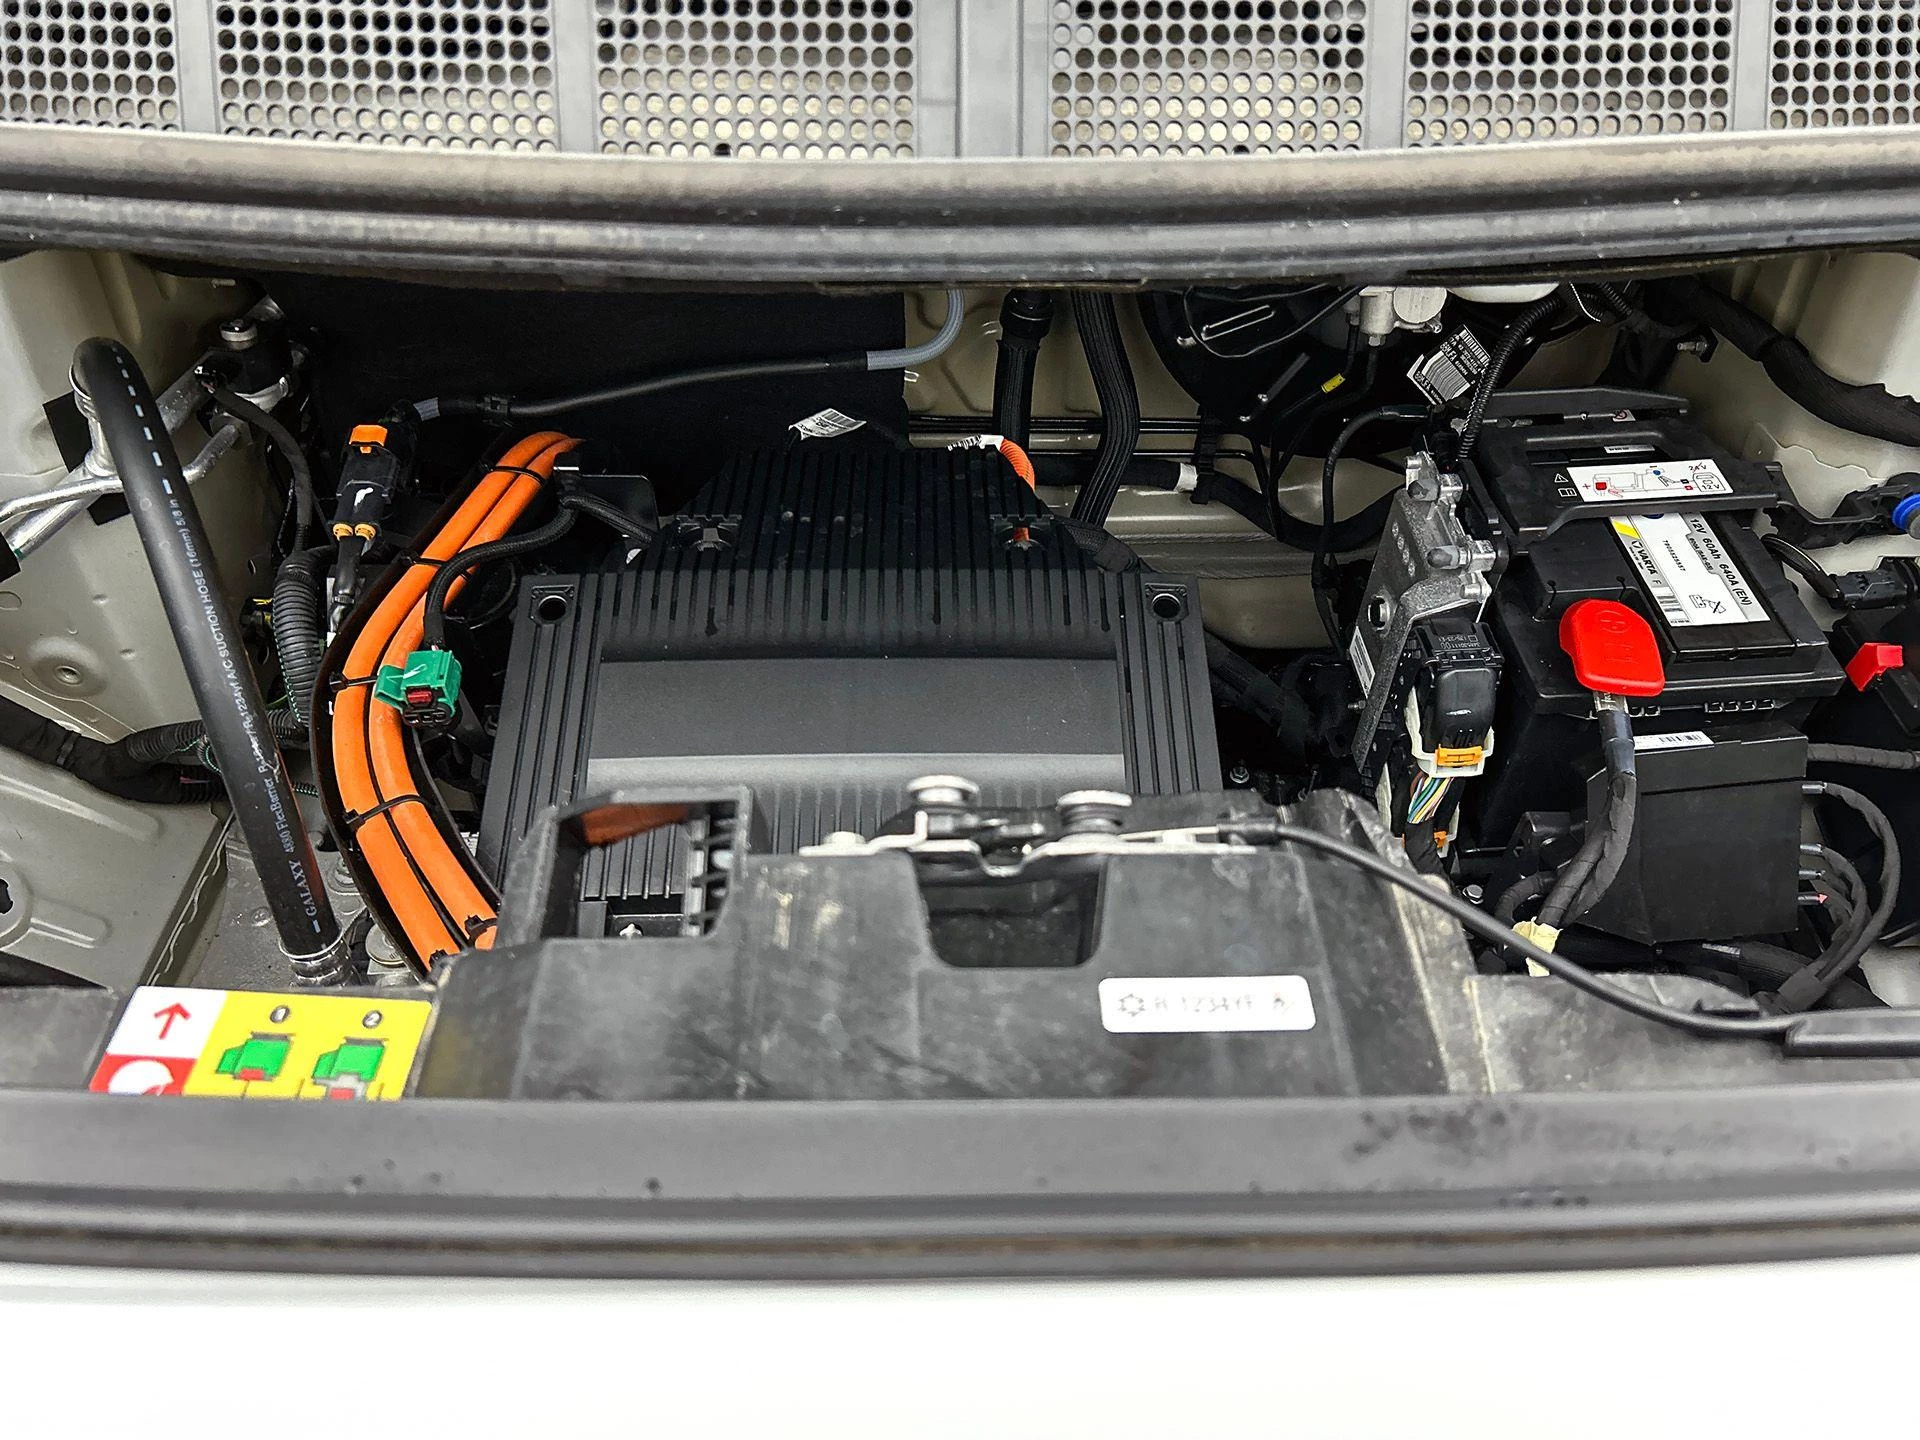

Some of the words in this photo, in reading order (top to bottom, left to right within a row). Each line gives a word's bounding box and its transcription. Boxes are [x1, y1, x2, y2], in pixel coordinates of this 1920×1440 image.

[178, 528, 202, 567] (16mm)
[1636, 549, 1658, 575] VARTA
[1690, 518, 1706, 534] 12V
[1702, 537, 1721, 560] 60Ah
[1719, 563, 1739, 586] 640A
[1732, 588, 1753, 606] (EN)
[193, 569, 212, 603] HOSE
[204, 605, 229, 657] SUCTION
[288, 860, 317, 916] GALAXY
